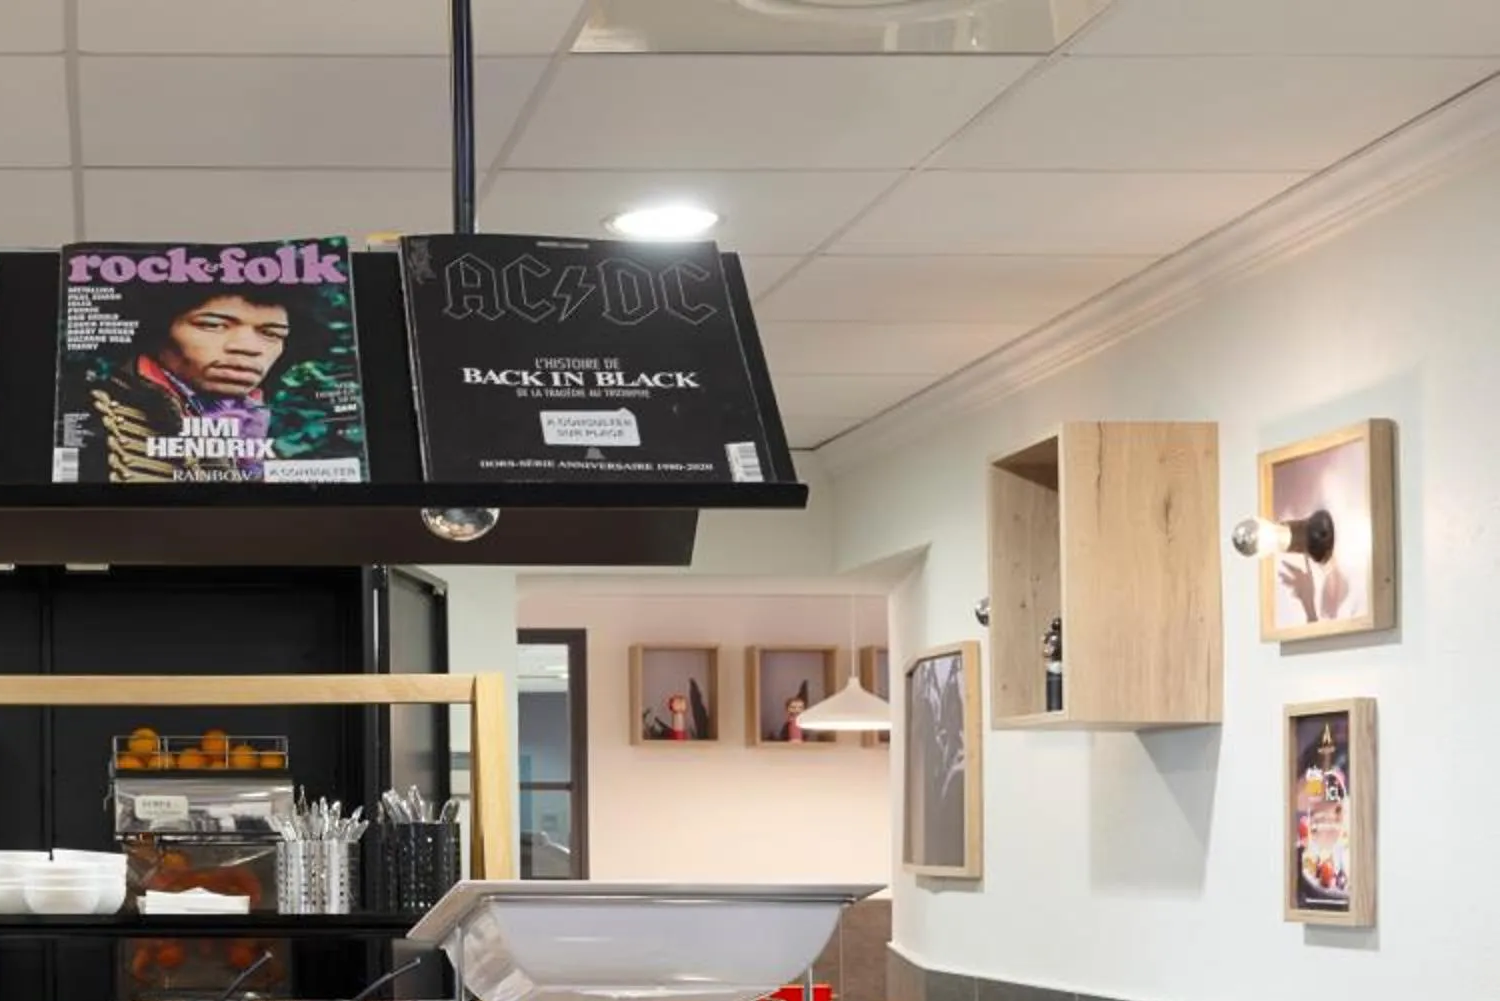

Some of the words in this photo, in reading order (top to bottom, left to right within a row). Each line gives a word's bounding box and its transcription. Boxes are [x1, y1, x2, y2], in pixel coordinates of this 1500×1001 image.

[462, 367, 546, 386] BACK
[551, 371, 584, 387] IN
[596, 371, 700, 388] BLACK
[178, 417, 239, 437] JIMI
[146, 437, 276, 459] HENDRIX
